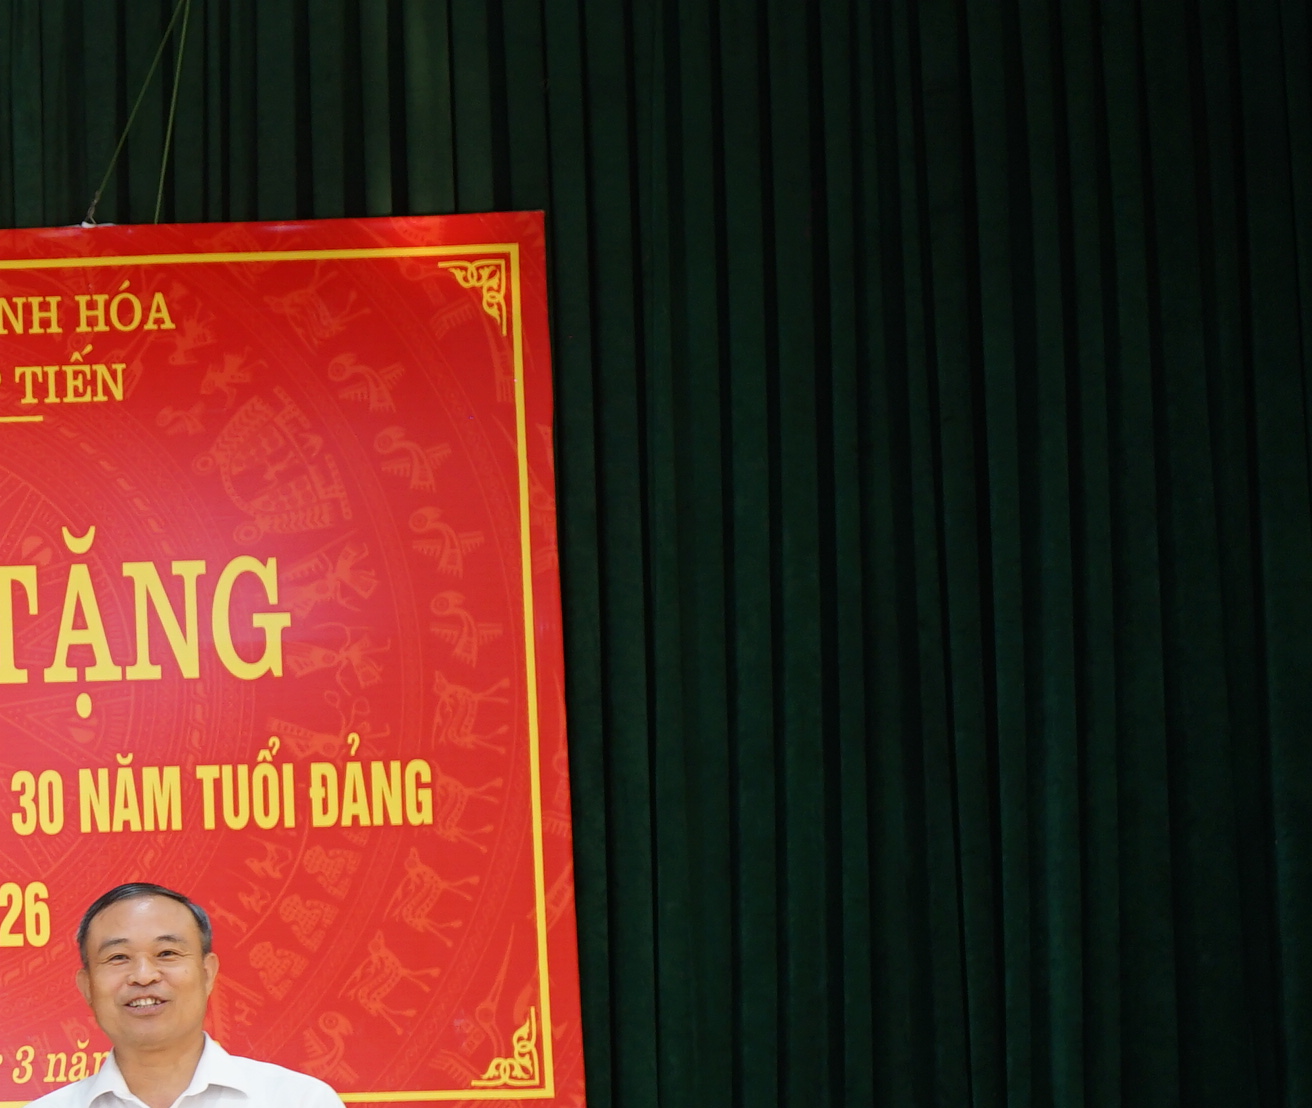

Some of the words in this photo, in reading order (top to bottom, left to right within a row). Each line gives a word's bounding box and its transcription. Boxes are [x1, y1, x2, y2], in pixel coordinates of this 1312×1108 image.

[75, 280, 175, 332] HÓA
[15, 344, 126, 404] TIẾN
[10, 769, 65, 836] 30
[78, 752, 183, 833] NĂM
[195, 736, 296, 830] TUỔI
[308, 732, 433, 828] ĐẢNG
[11, 1045, 35, 1084] 3
